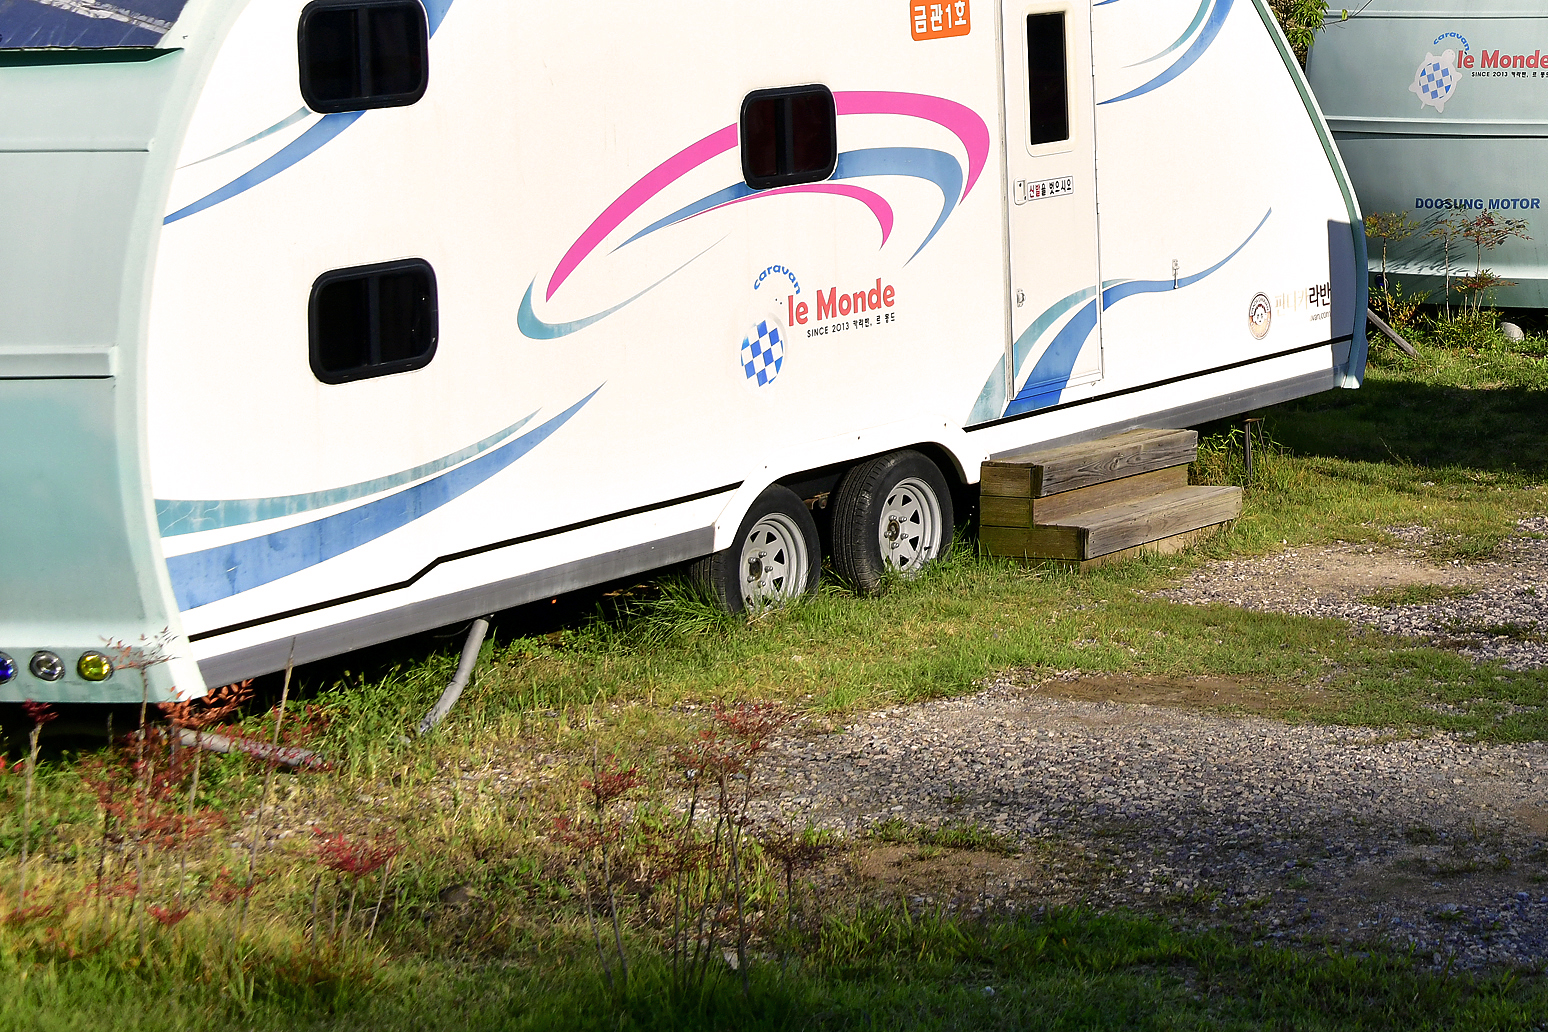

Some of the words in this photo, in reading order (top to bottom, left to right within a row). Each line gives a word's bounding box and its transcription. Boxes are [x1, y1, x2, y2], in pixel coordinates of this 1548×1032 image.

[914, 0, 967, 34] 금관1호
[1433, 31, 1470, 51] caravan
[1457, 49, 1475, 69] le
[1415, 197, 1484, 210] DOOSUNG
[1488, 197, 1541, 210] MOTOR
[753, 264, 801, 295] caravan
[787, 294, 809, 327] le
[816, 277, 896, 321] Monde
[806, 325, 829, 338] SINCE
[832, 321, 850, 333] 2013
